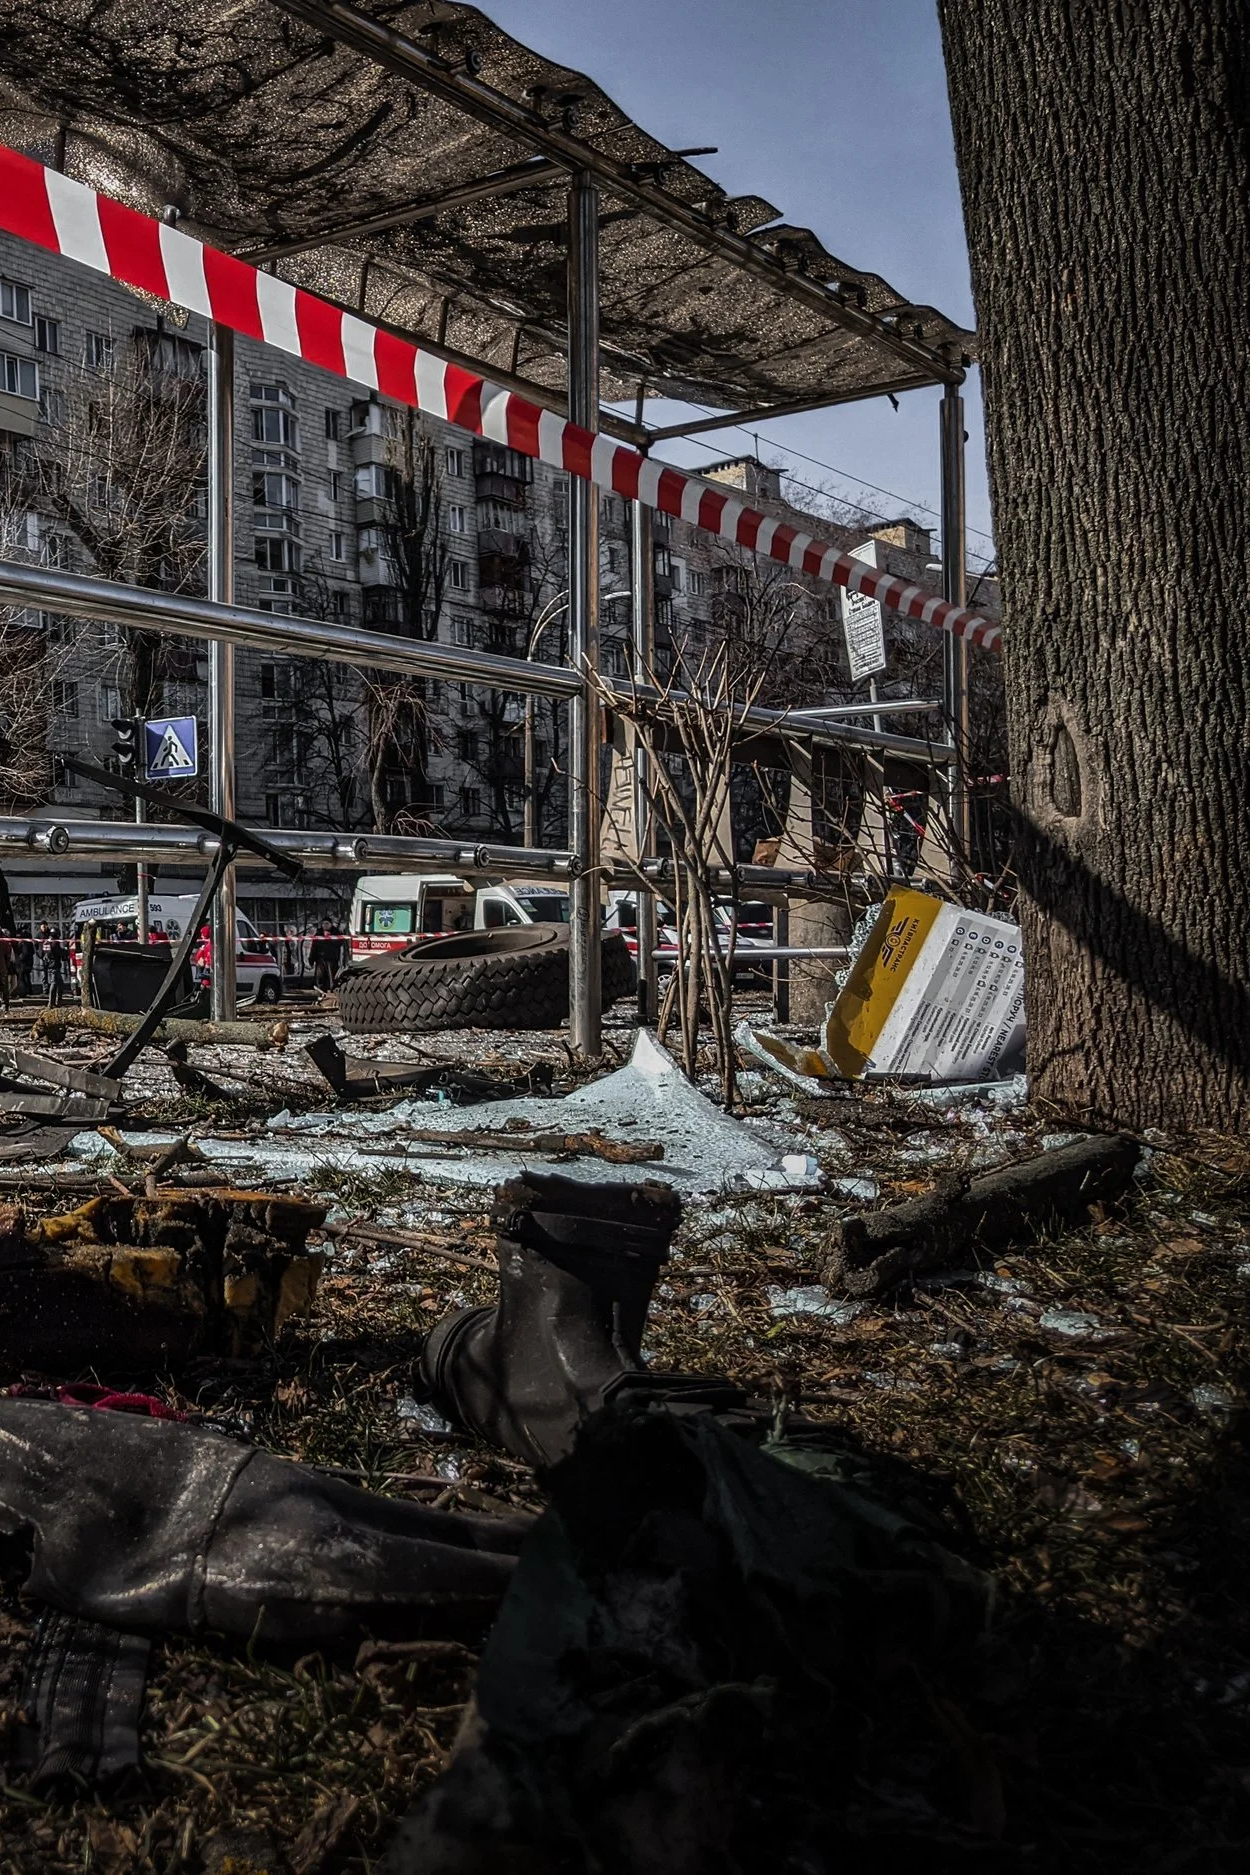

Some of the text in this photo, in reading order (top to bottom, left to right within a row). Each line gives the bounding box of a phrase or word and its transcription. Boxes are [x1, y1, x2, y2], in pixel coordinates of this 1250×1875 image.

[80, 904, 135, 918] AMBULANCE
[888, 917, 920, 973] КИЇВПАСТРАНС
[985, 1028, 1008, 1066] NEAREST
